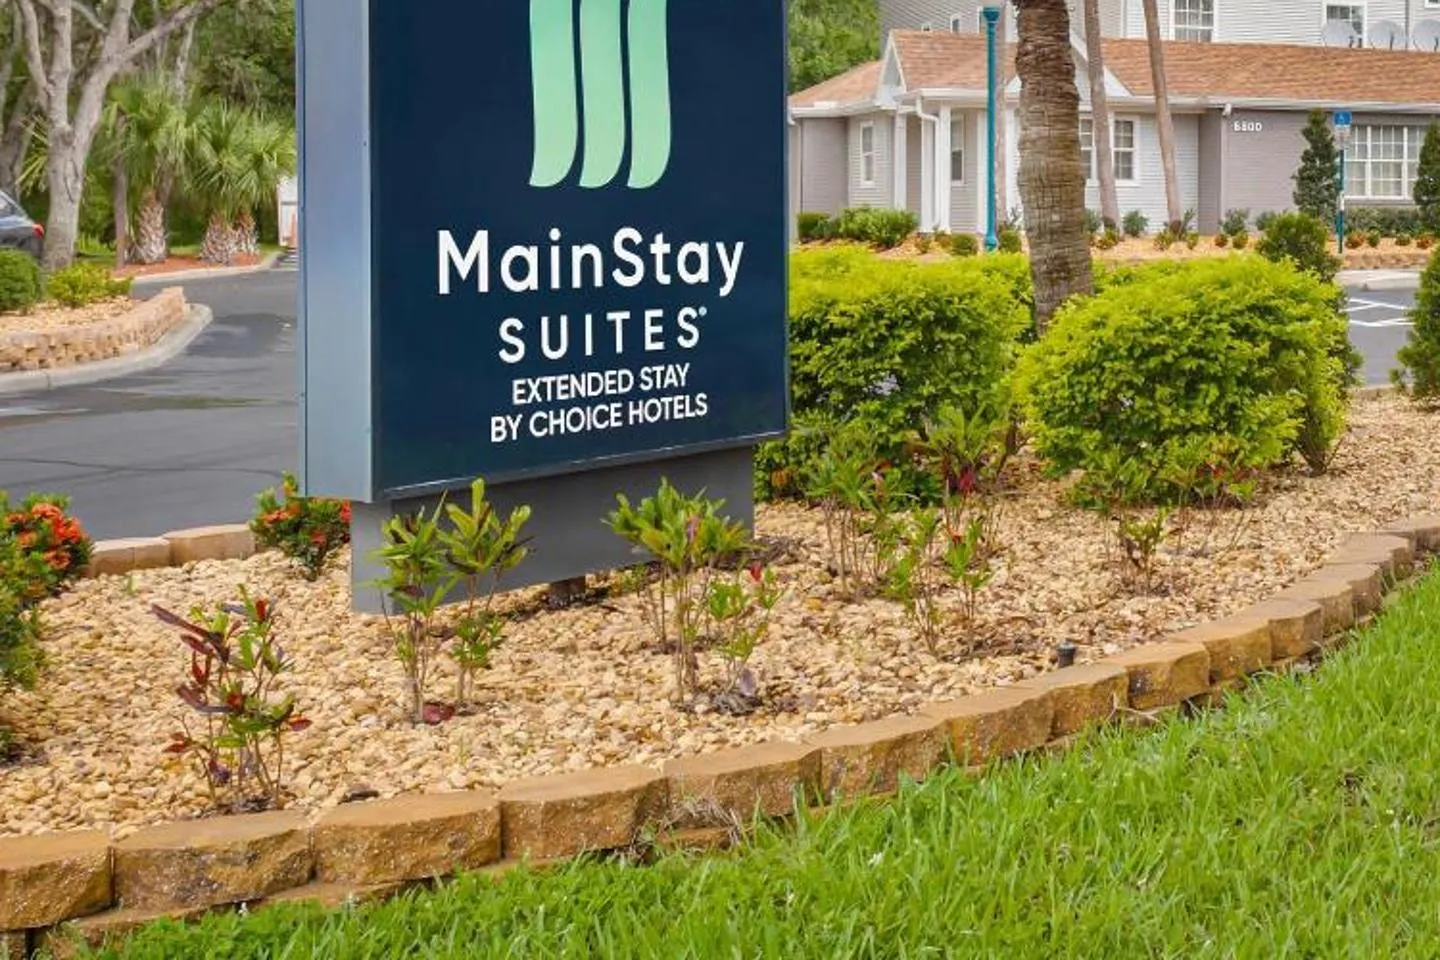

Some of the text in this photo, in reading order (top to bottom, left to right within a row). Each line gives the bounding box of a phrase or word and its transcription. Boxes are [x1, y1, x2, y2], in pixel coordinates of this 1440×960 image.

[438, 227, 744, 297] MainStay
[512, 362, 690, 405] EXTENDED STAY
[490, 392, 708, 443] BY CHOICE HOTELS
